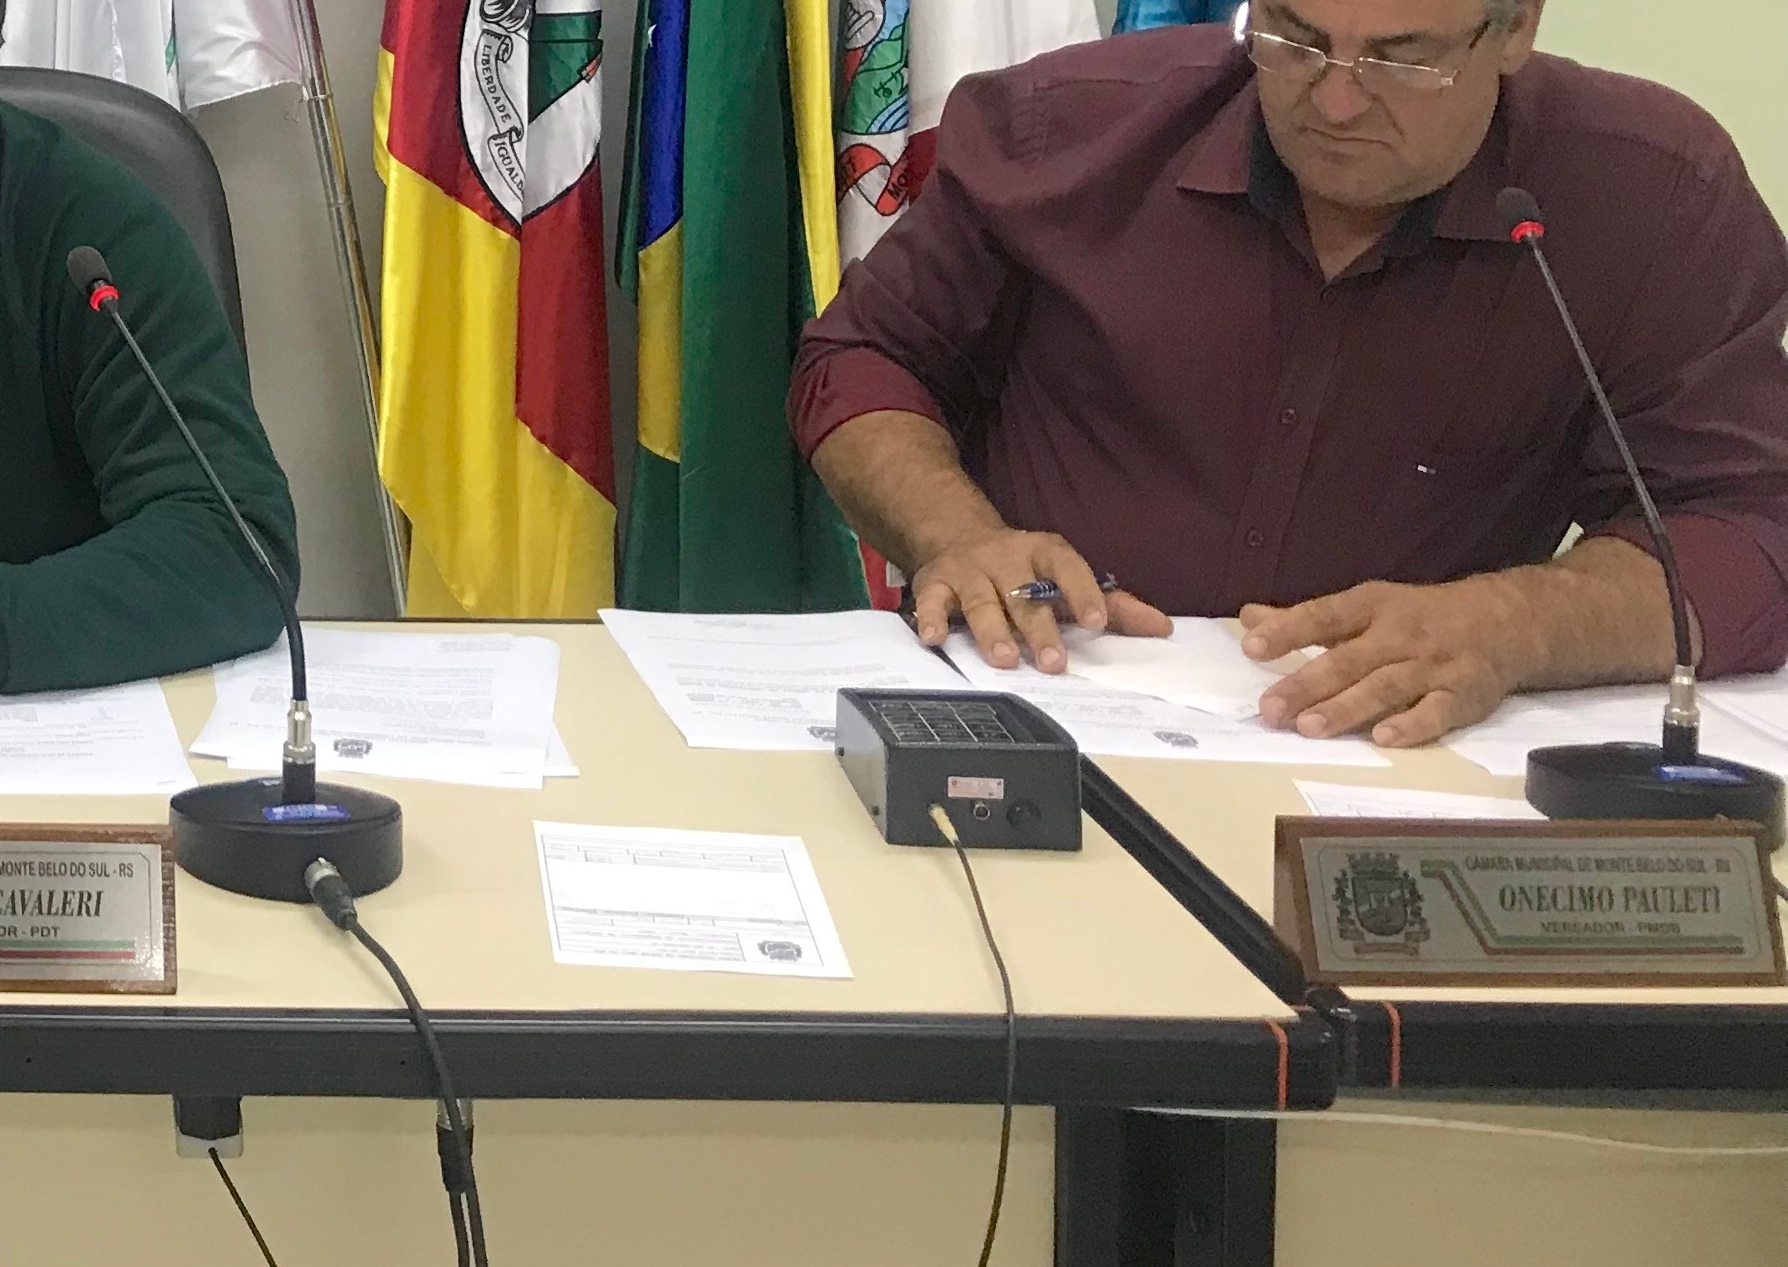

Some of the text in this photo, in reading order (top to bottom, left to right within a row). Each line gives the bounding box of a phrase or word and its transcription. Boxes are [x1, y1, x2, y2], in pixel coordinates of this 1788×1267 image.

[480, 43, 512, 124] LIBERDADE
[38, 861, 67, 877] BELO
[70, 862, 86, 878] DO
[88, 862, 110, 878] SUL
[119, 862, 134, 878] RS
[1498, 884, 1721, 913] ONECIMO PAULETI
[30, 925, 60, 938] PDT
